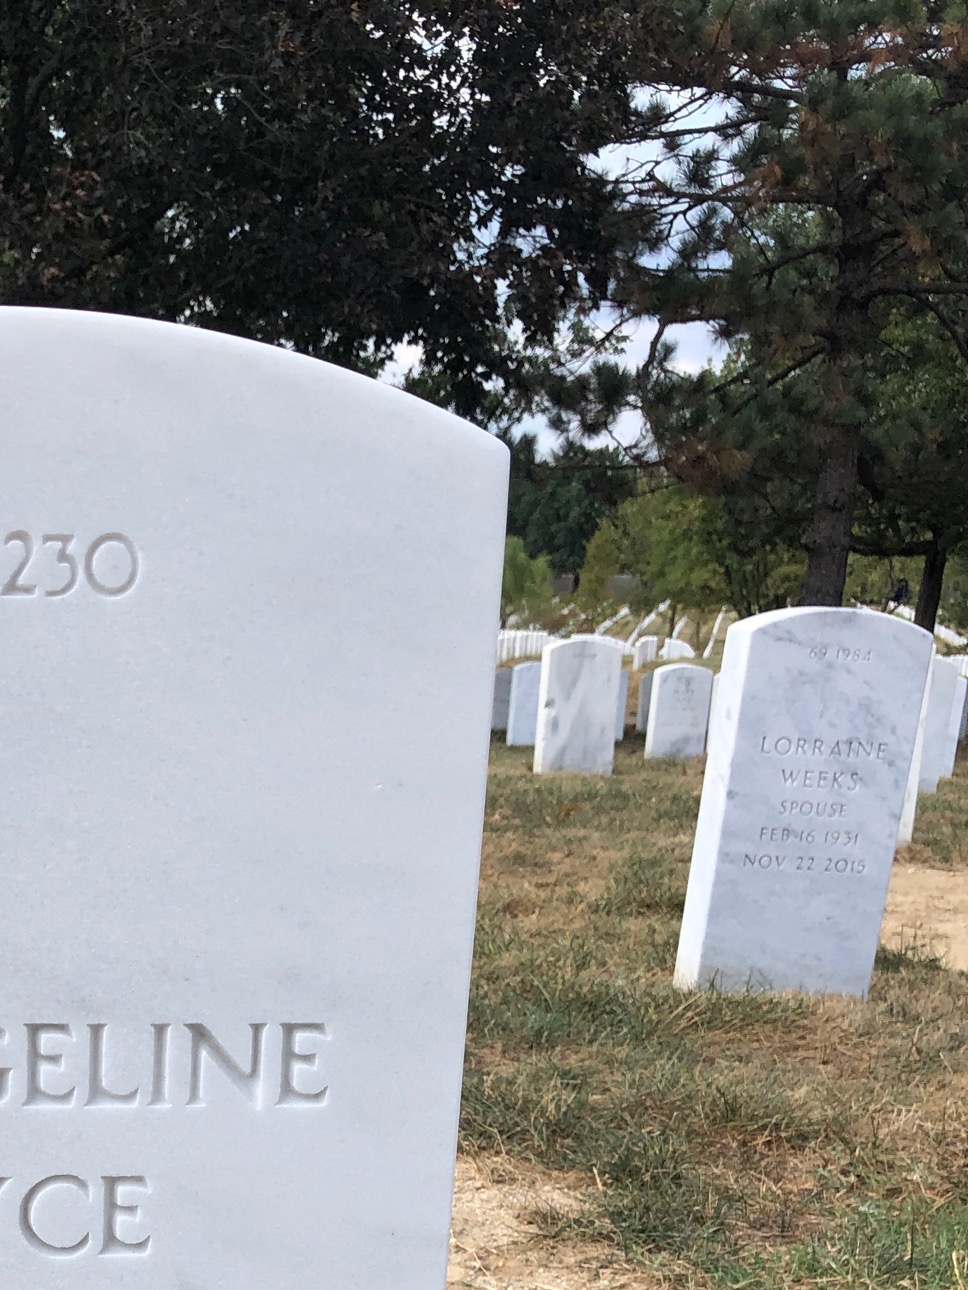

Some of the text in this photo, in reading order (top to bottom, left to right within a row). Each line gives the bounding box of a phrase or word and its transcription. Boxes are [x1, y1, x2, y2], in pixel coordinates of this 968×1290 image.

[809, 645, 828, 661] 69
[760, 736, 888, 760] LORRAINE
[781, 768, 860, 791] WEEKS
[778, 800, 848, 818] SPOUSE
[759, 826, 859, 846] FEB 16 1931
[743, 853, 866, 874] NOV 22 2015
